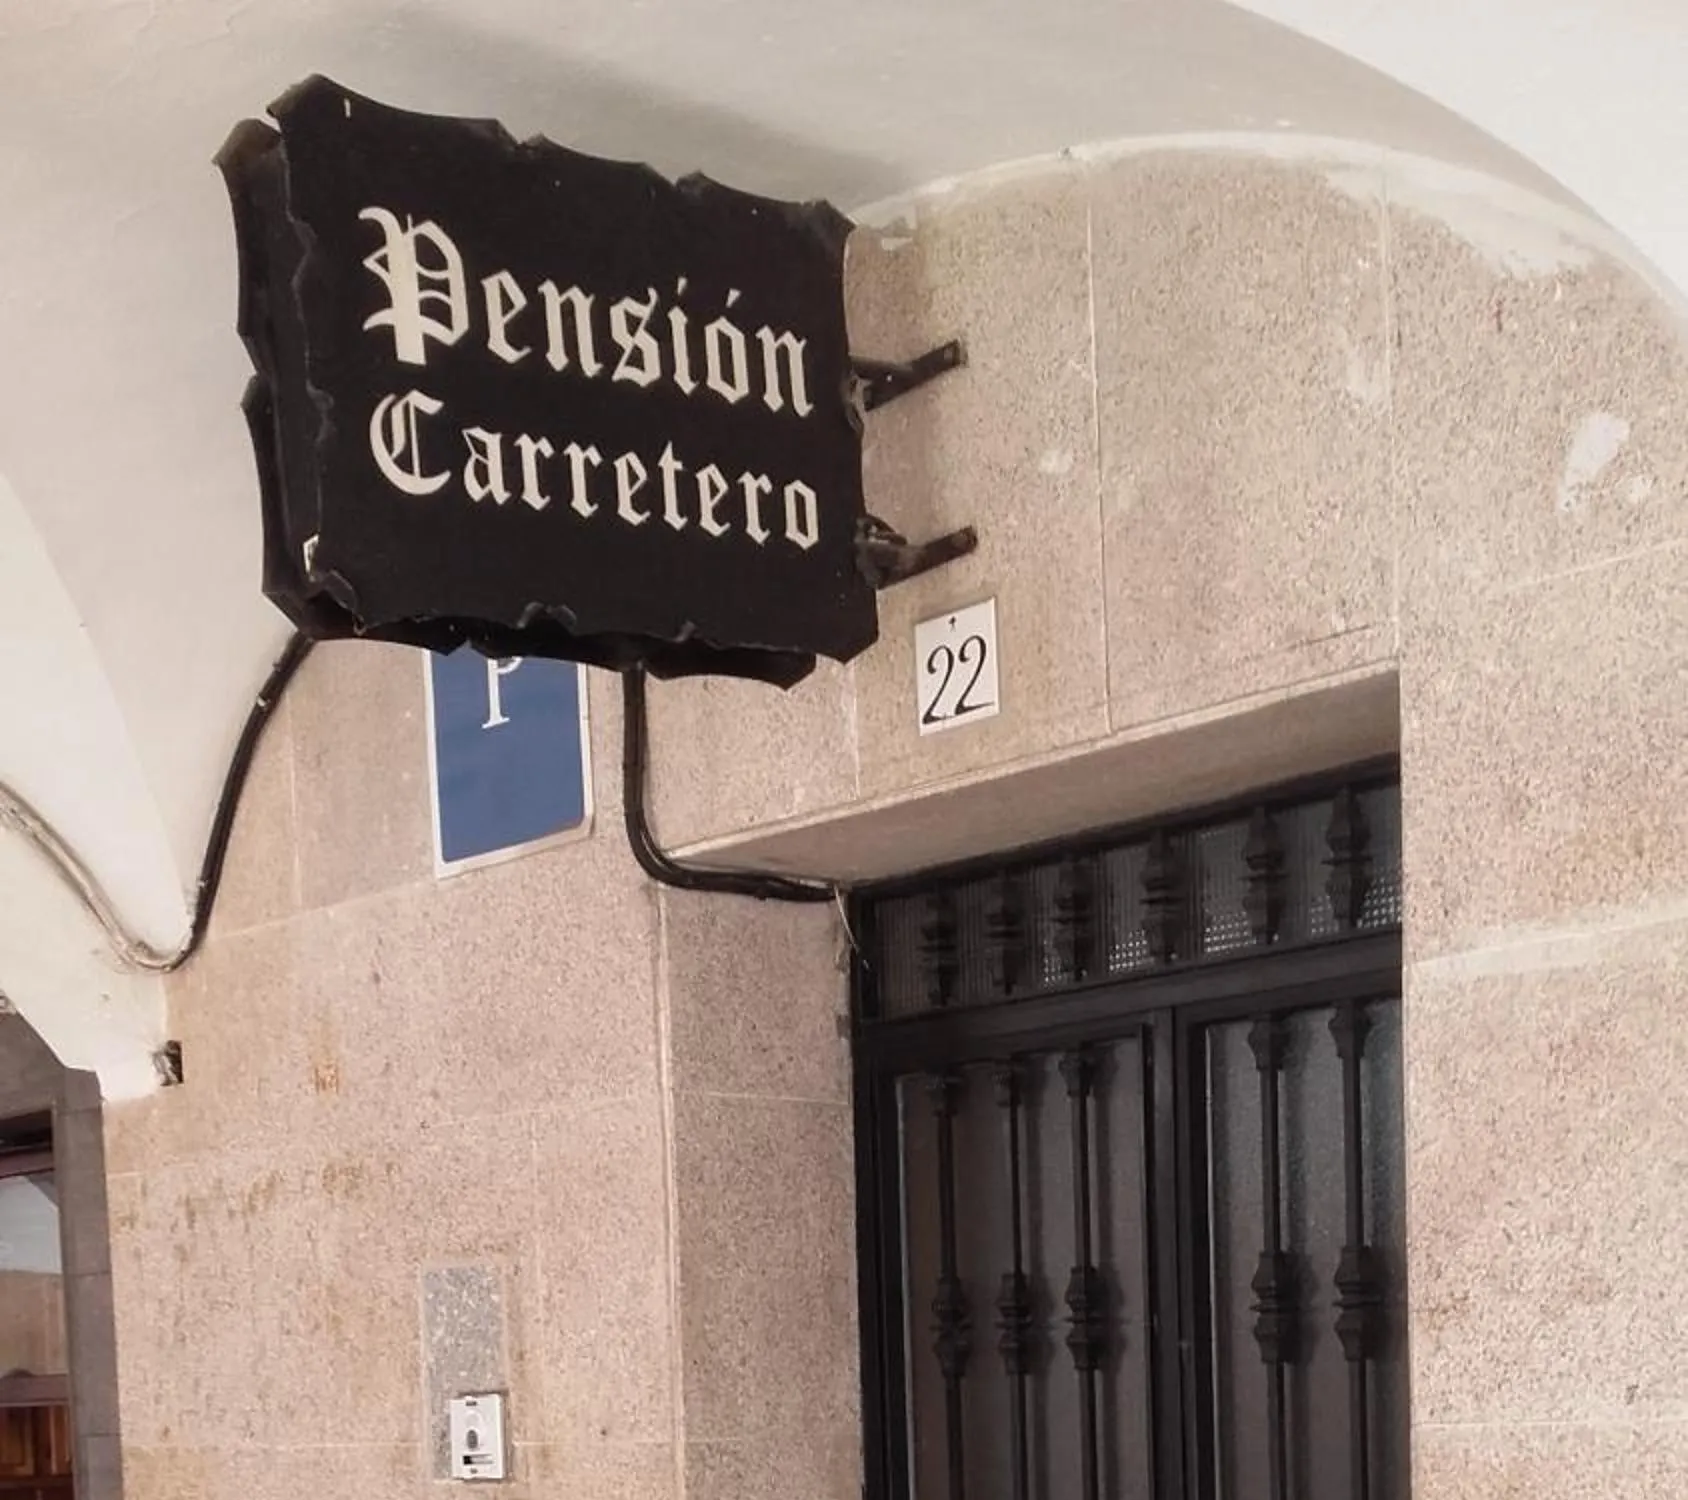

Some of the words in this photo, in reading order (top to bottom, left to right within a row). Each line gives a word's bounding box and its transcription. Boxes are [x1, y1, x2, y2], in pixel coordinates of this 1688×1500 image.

[357, 206, 814, 418] Pensión
[369, 389, 820, 550] Carretero
[922, 635, 994, 724] 22
